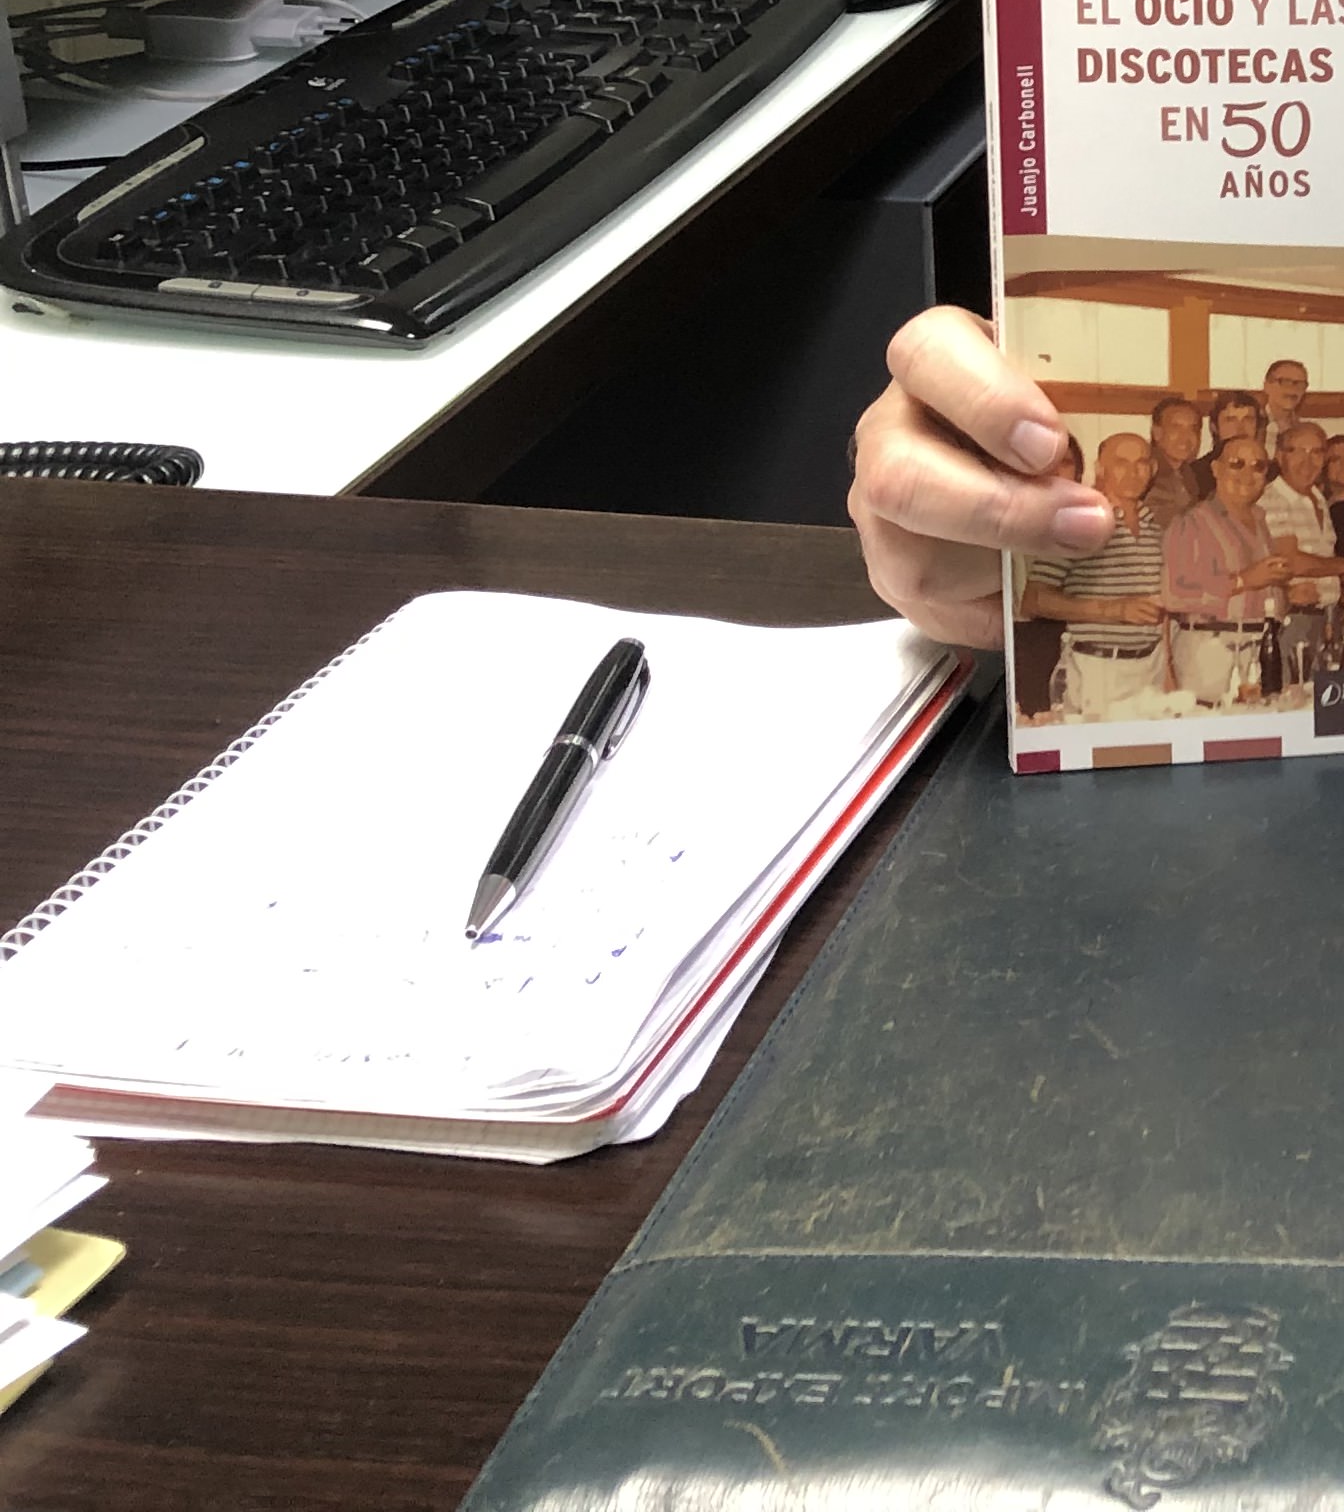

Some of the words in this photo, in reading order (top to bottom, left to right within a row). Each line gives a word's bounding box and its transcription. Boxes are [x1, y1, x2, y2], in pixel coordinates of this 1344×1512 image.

[1077, 46, 1334, 84] DISCOTECAS
[1017, 65, 1037, 147] Carbonell
[1161, 106, 1209, 143] EN
[1221, 100, 1311, 159] 50
[1020, 153, 1039, 218] Juanjo
[1220, 166, 1311, 199] AÑOS
